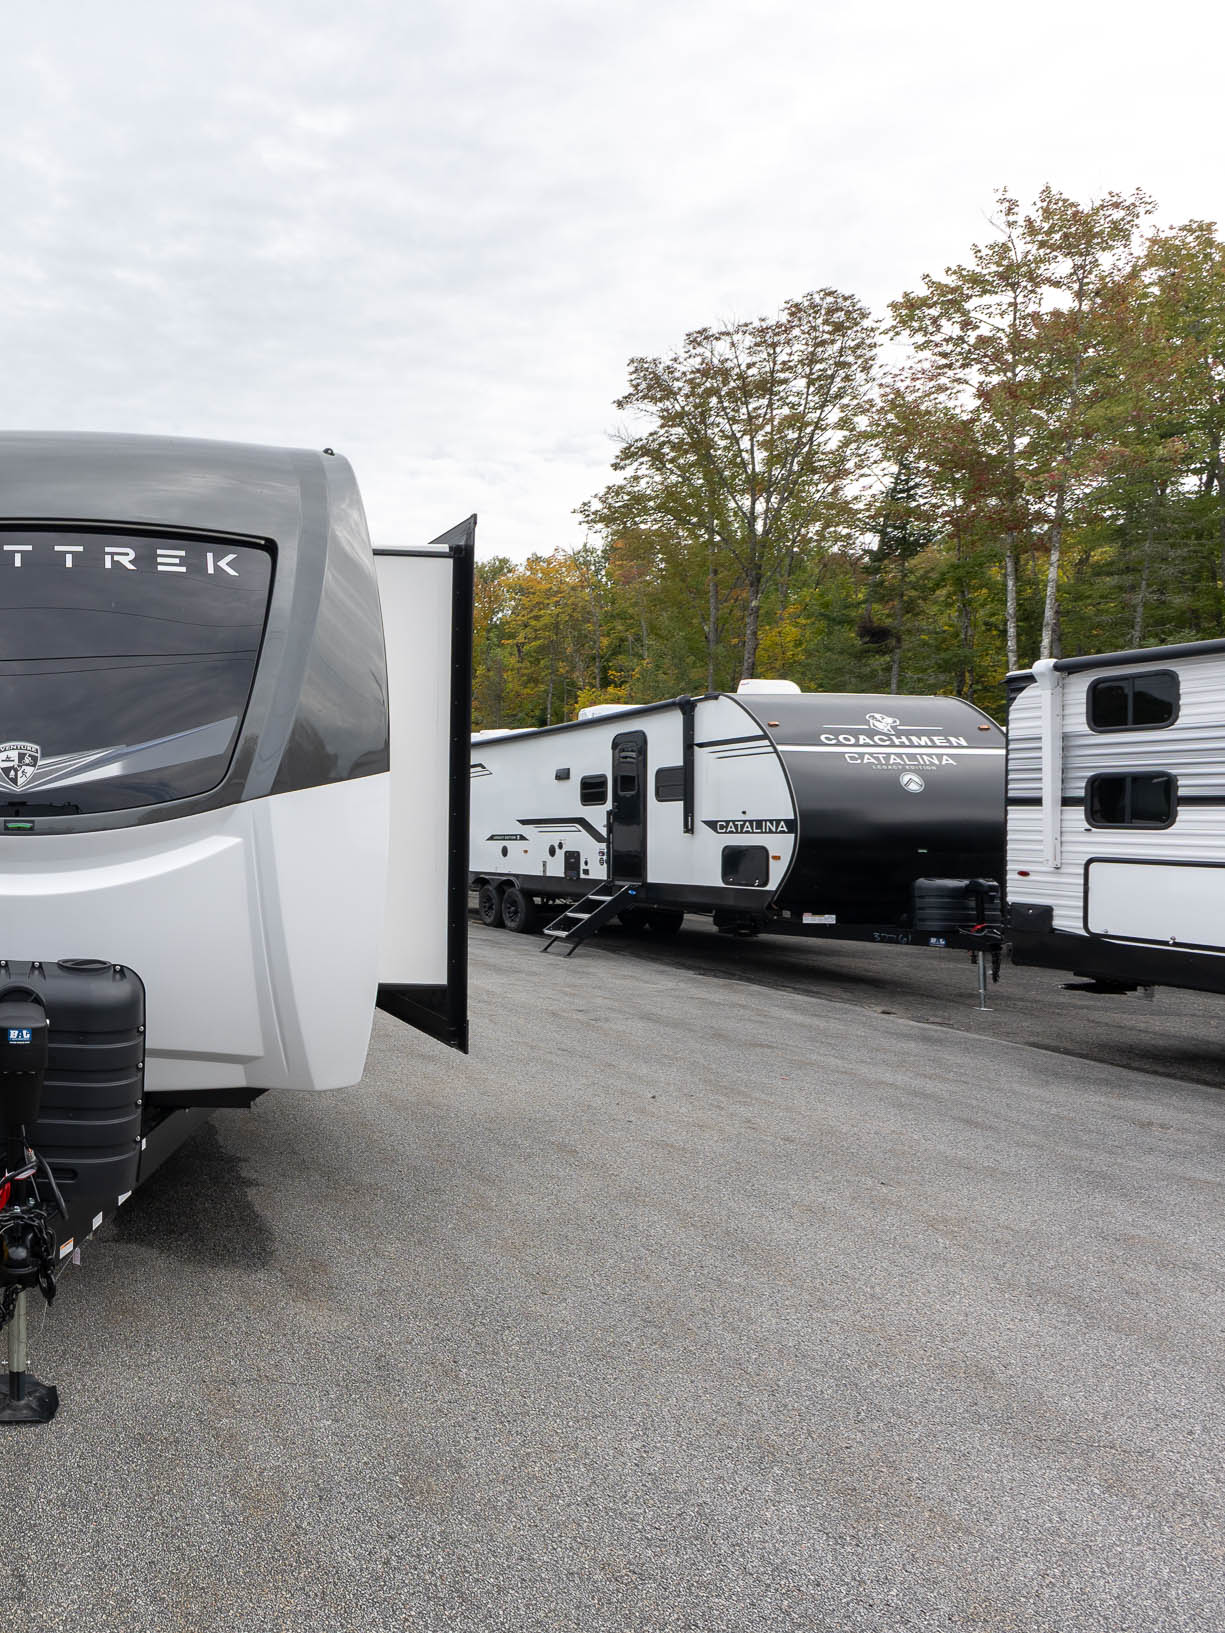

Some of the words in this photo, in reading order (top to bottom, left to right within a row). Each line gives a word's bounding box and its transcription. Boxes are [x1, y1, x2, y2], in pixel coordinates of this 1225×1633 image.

[820, 734, 969, 747] COACHMEN
[0, 744, 37, 753] VENTURE
[844, 753, 957, 766] CATALINA
[717, 821, 788, 833] CATALINA
